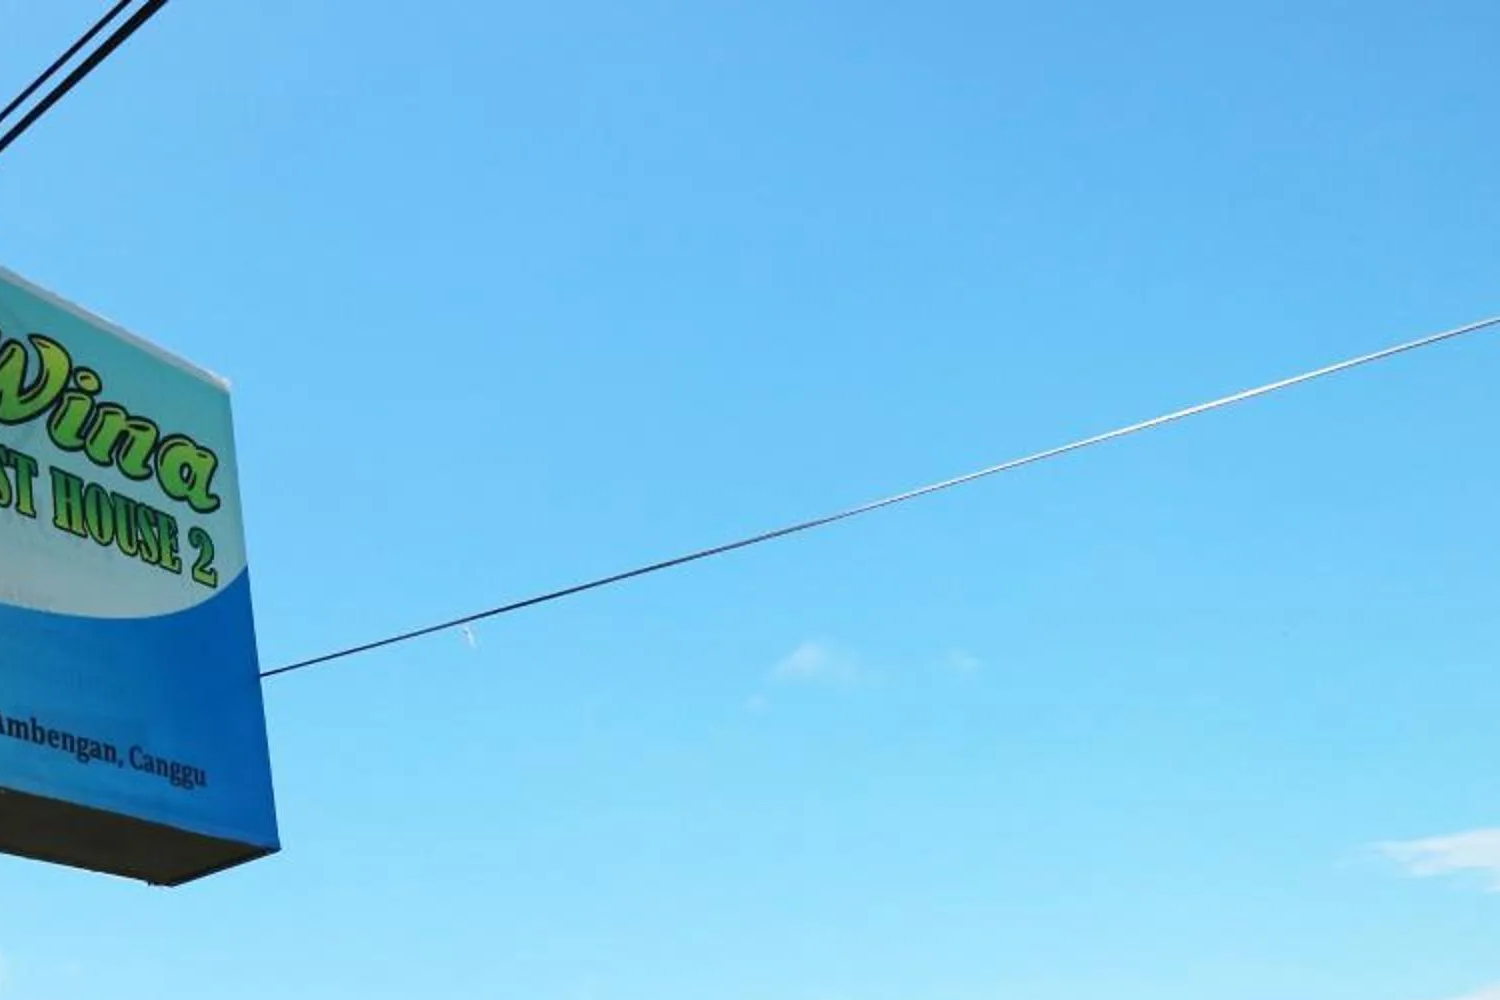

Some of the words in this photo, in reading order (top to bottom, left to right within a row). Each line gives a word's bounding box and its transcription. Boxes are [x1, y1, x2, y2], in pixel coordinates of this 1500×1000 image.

[51, 466, 181, 575] HOUSE
[188, 525, 218, 587] 2
[129, 745, 208, 790] Canggu
